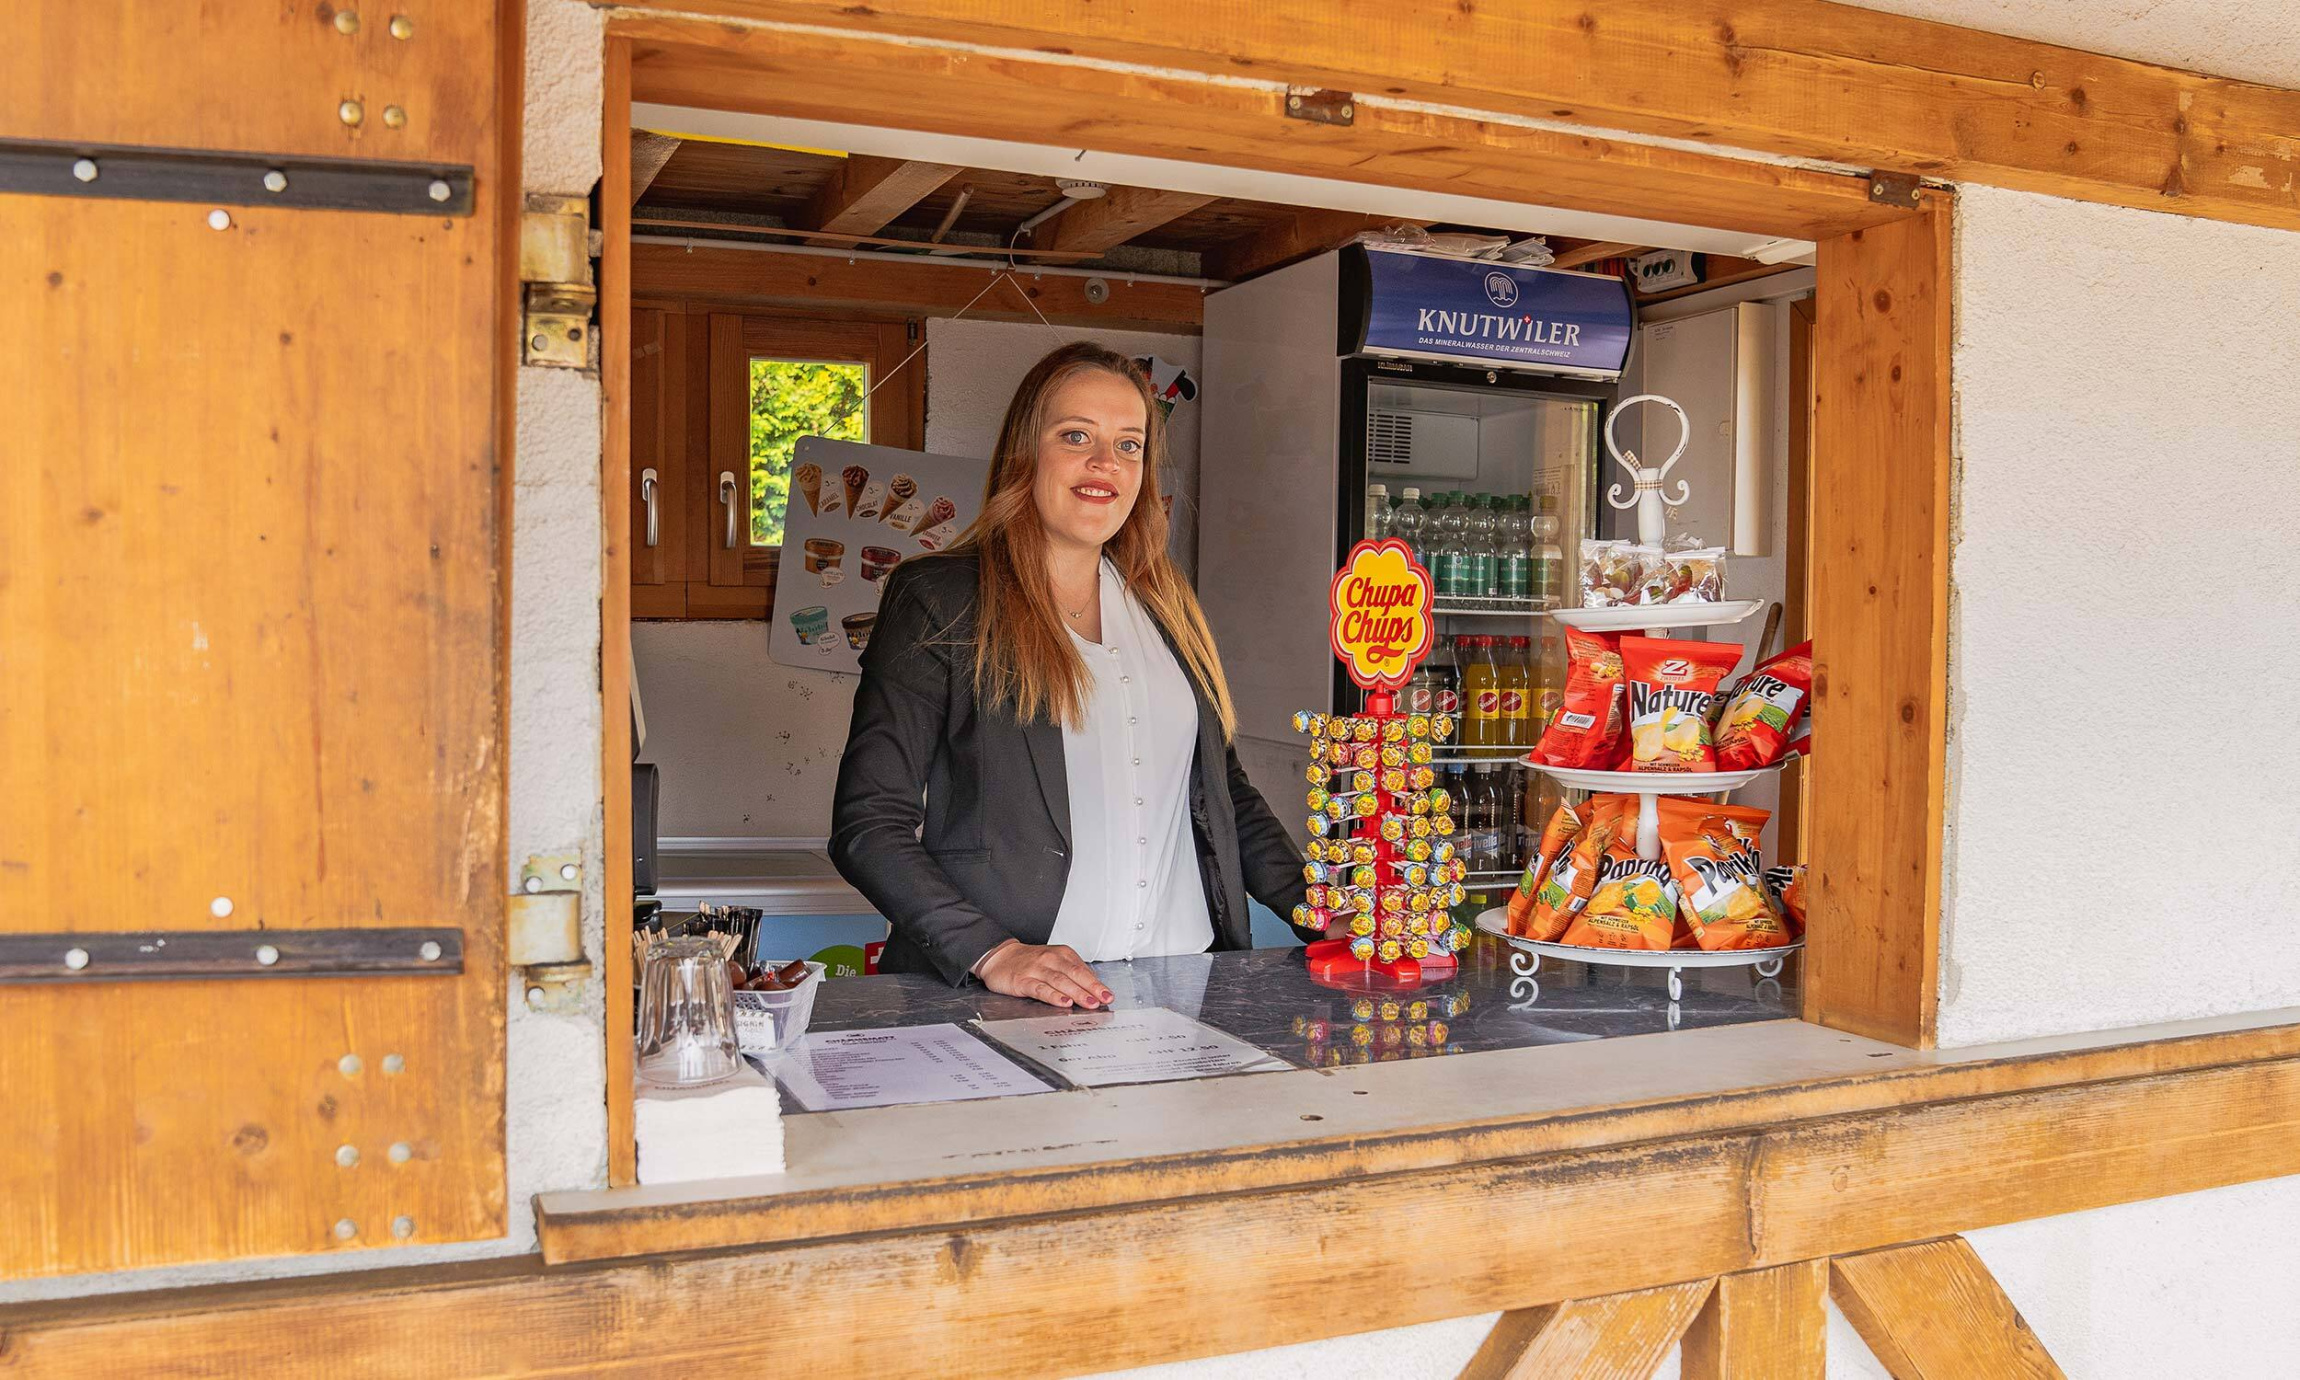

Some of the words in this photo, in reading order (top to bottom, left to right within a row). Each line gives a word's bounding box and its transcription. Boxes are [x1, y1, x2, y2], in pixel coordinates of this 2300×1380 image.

[1417, 308, 1581, 347] KNUTWILER
[1418, 337, 1433, 345] DAS
[1434, 338, 1494, 351] MINERALWASSER
[1495, 344, 1510, 352] DER
[1510, 346, 1572, 358] ZENTRALSCHWEIZ
[856, 500, 878, 512] CHOCOLAT
[889, 513, 912, 523] VANILLE
[1346, 577, 1418, 616] Chupa
[1343, 610, 1414, 664] Chups
[1630, 681, 1711, 723] Nature
[835, 964, 857, 977] Die
